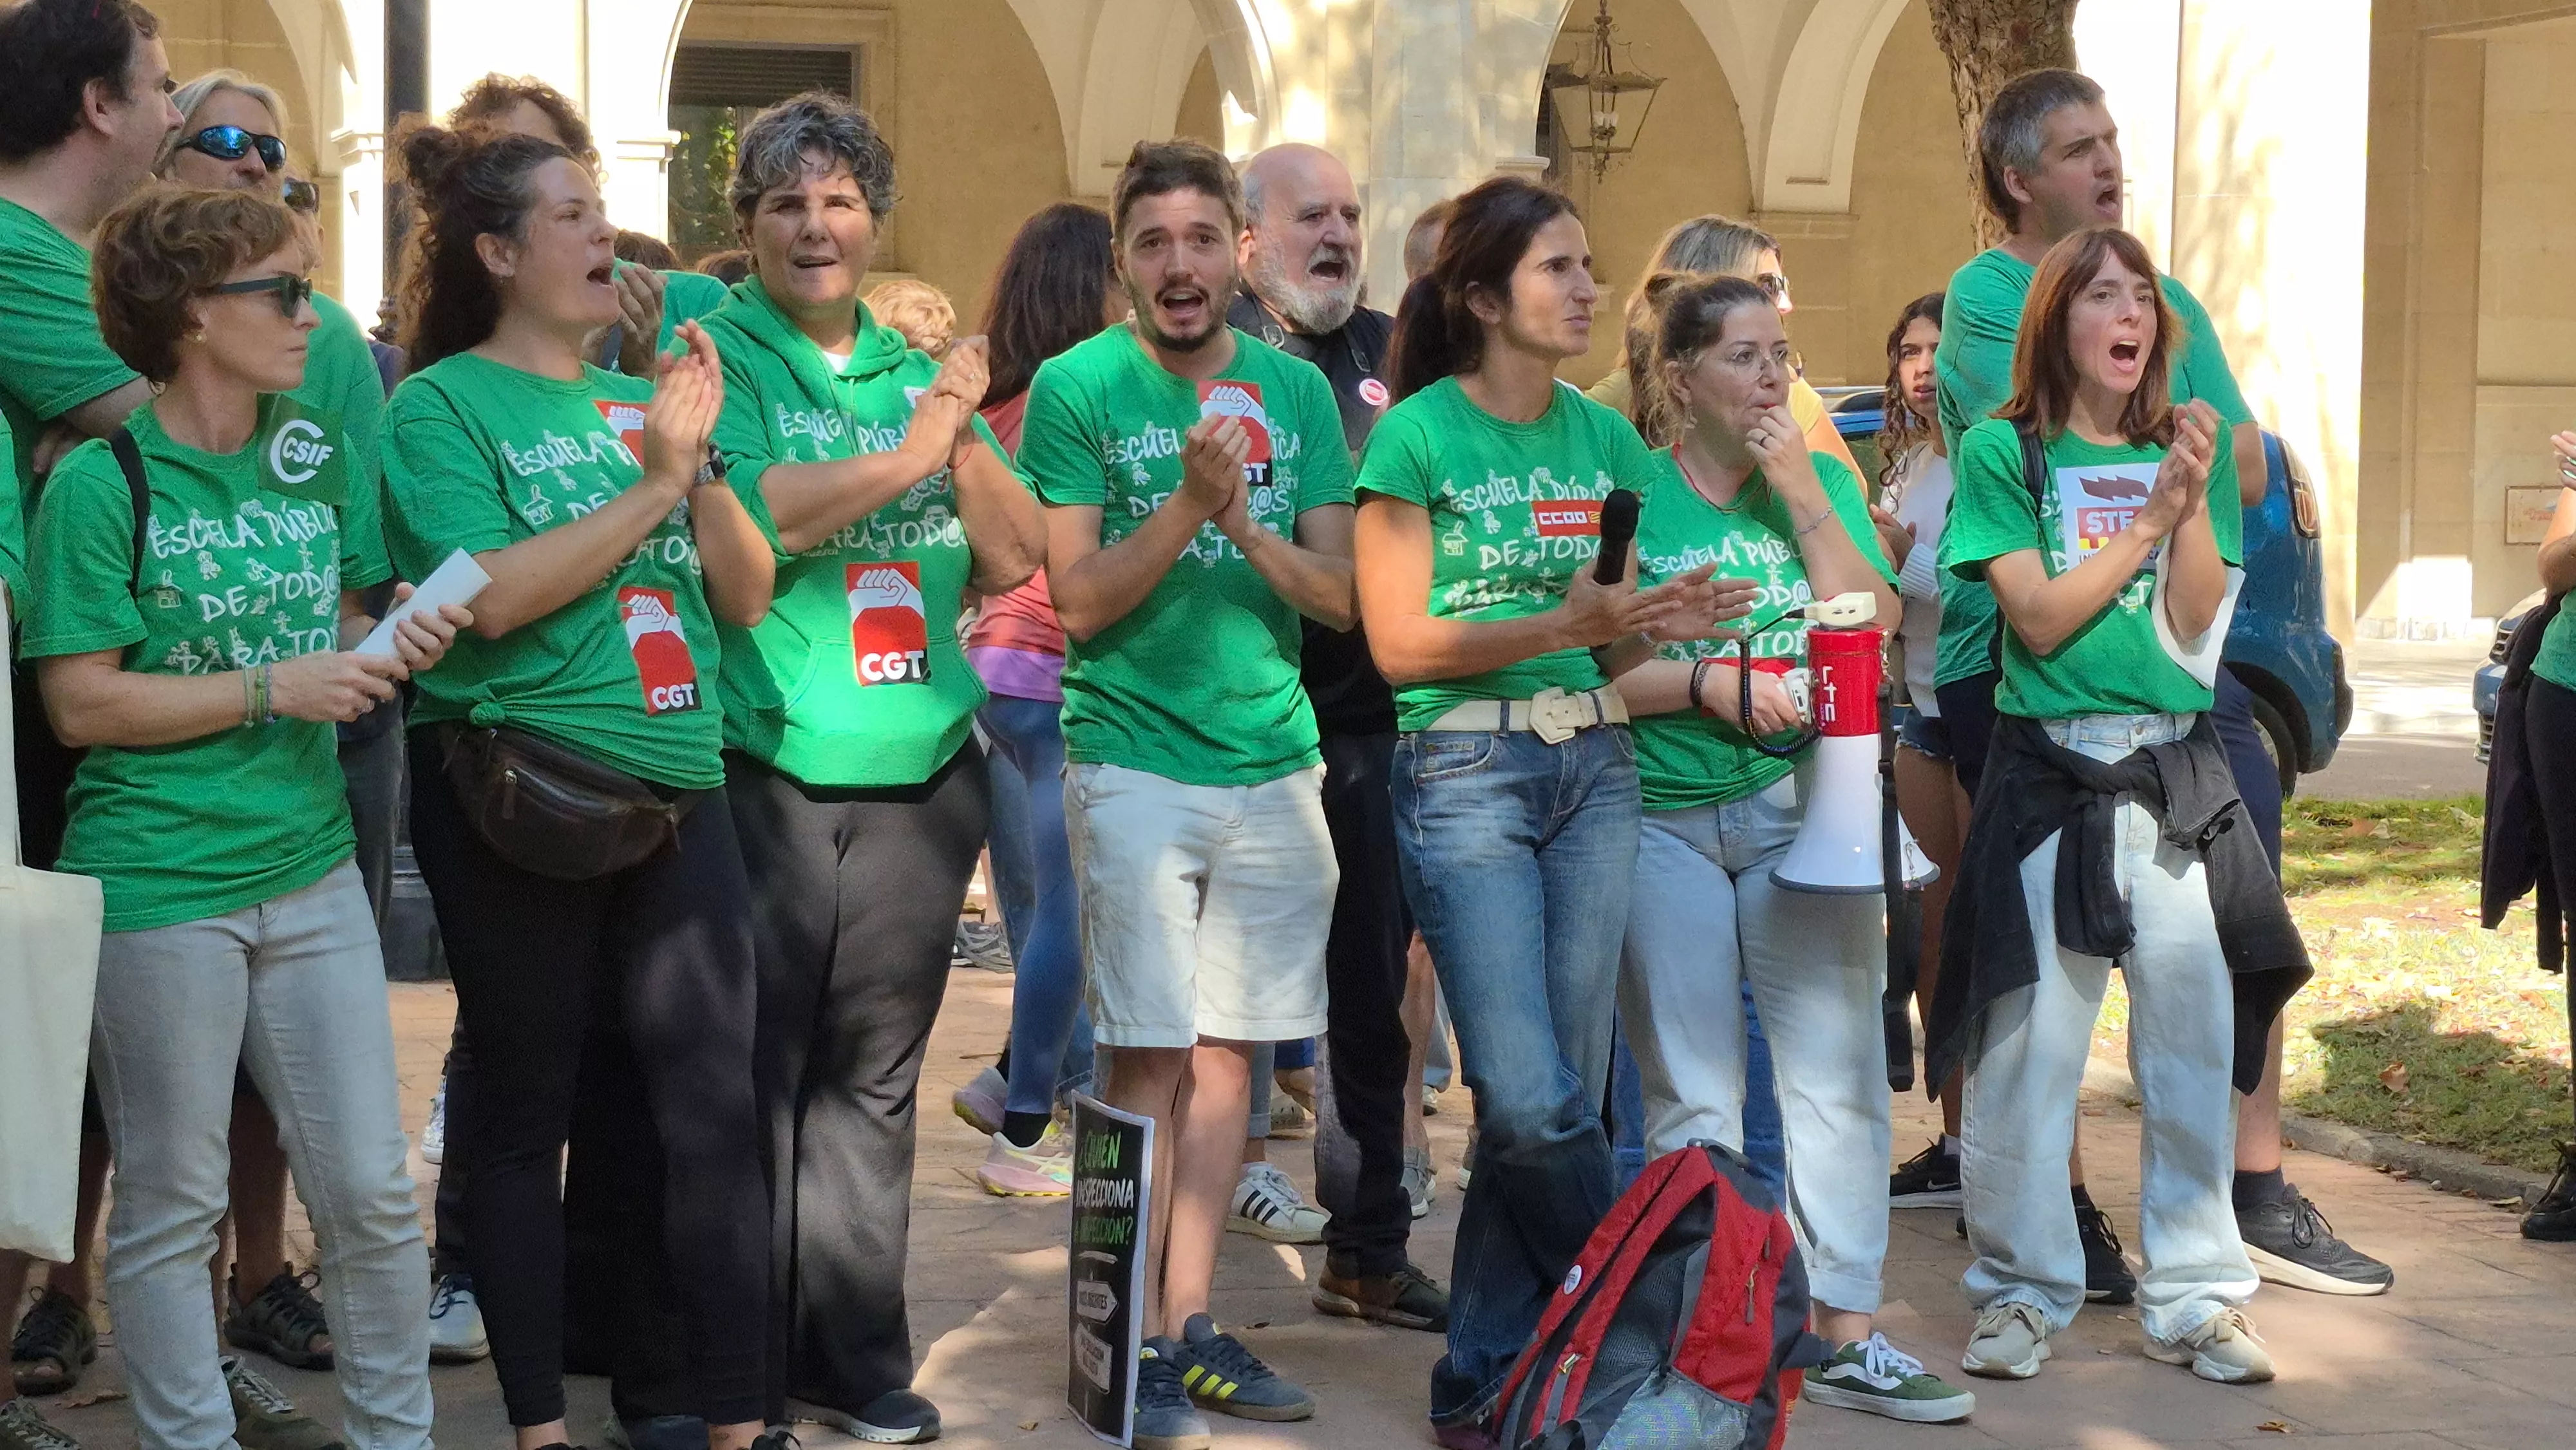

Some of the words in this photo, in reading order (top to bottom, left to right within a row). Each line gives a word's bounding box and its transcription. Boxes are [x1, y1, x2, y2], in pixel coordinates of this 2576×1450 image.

[283, 437, 334, 466] CSIF
[1103, 428, 1181, 464] ESCUEL
[1242, 462, 1267, 483] GT
[2086, 511, 2134, 533] STE
[1479, 540, 1520, 570] DE
[199, 585, 247, 623] DE
[861, 650, 924, 681] CGT
[652, 683, 694, 710] CGT
[1075, 1177, 1134, 1209] INSPECCIONA
